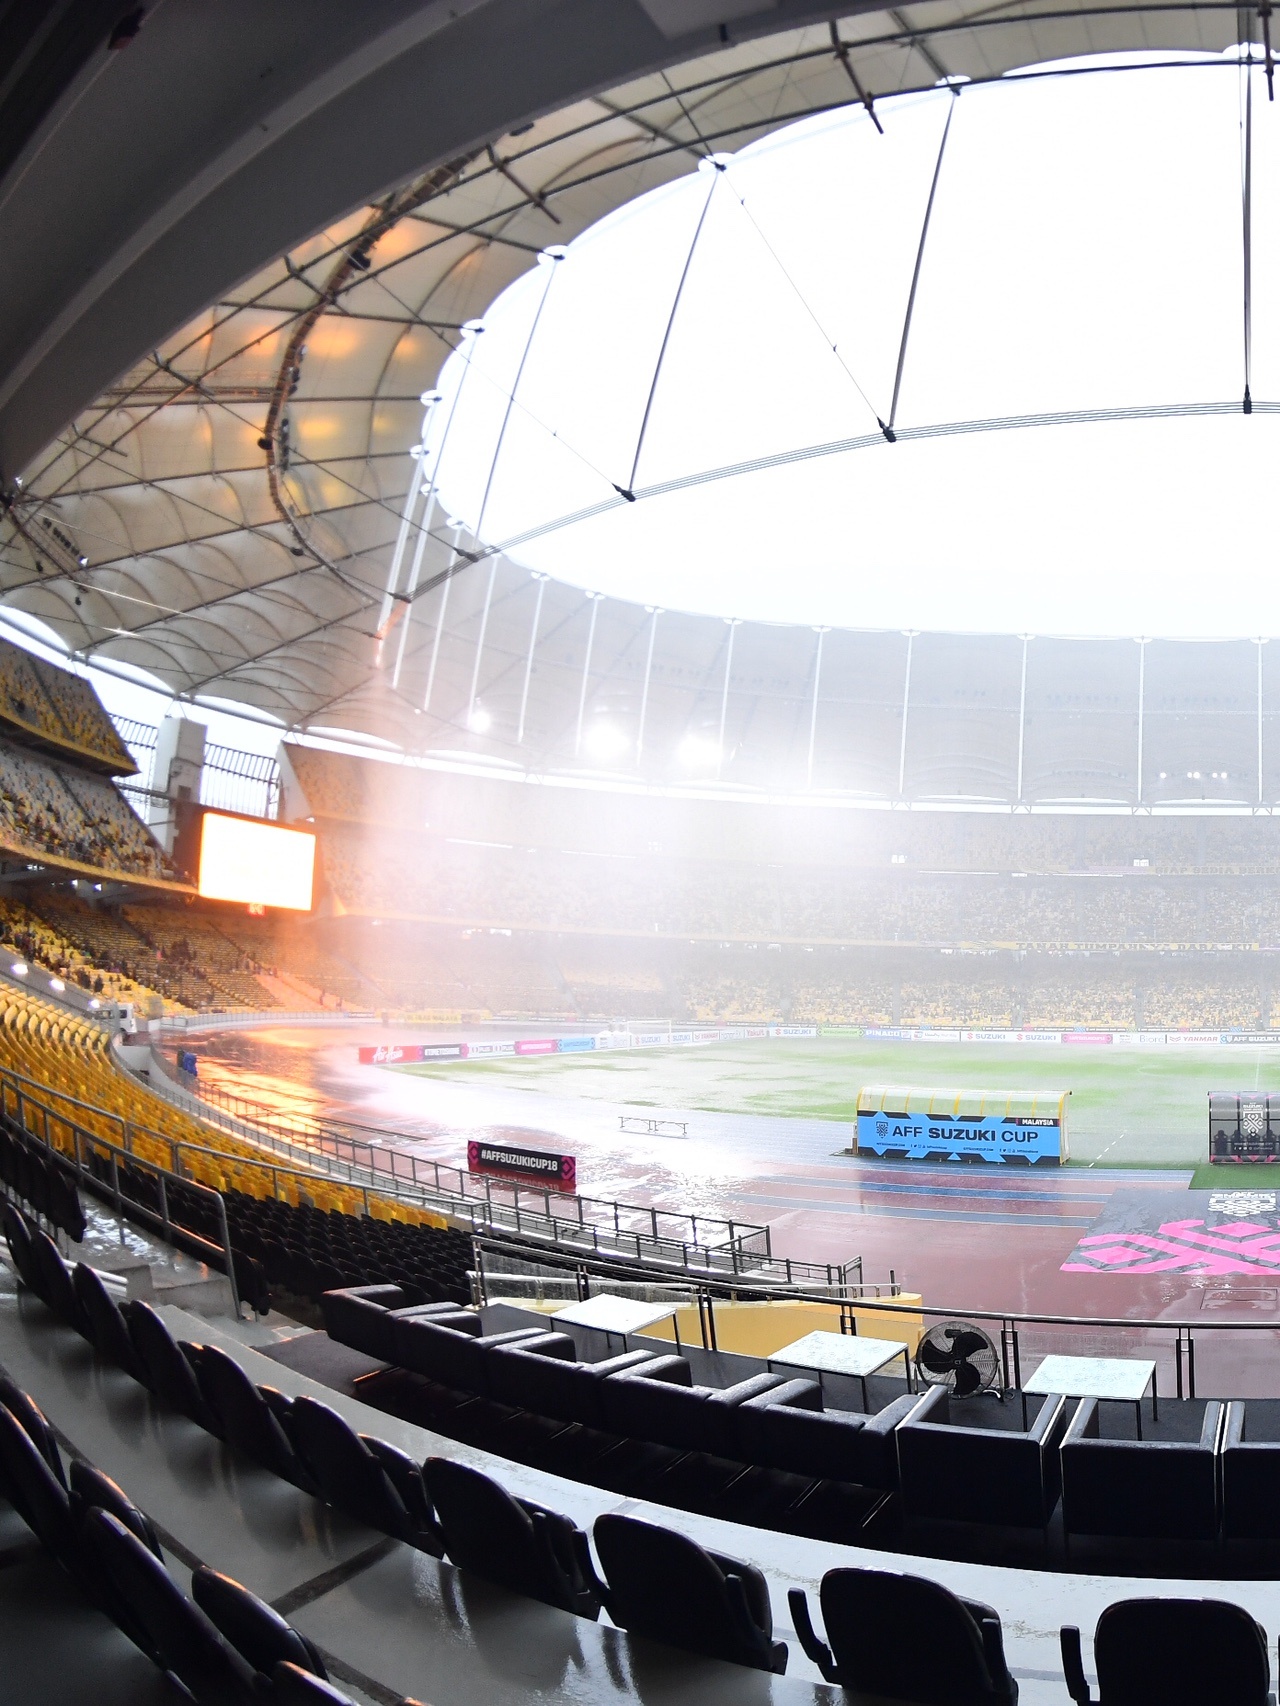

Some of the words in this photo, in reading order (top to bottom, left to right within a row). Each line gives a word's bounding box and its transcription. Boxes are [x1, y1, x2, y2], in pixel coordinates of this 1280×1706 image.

[641, 1036, 661, 1044] SUZUKI
[1021, 1118, 1054, 1126] MALAYSIA
[892, 1126, 923, 1138] AFF
[928, 1127, 996, 1141] SUZUKI
[1001, 1130, 1038, 1143] CUP
[481, 1149, 558, 1171] #AFFSUZUKICUP18
